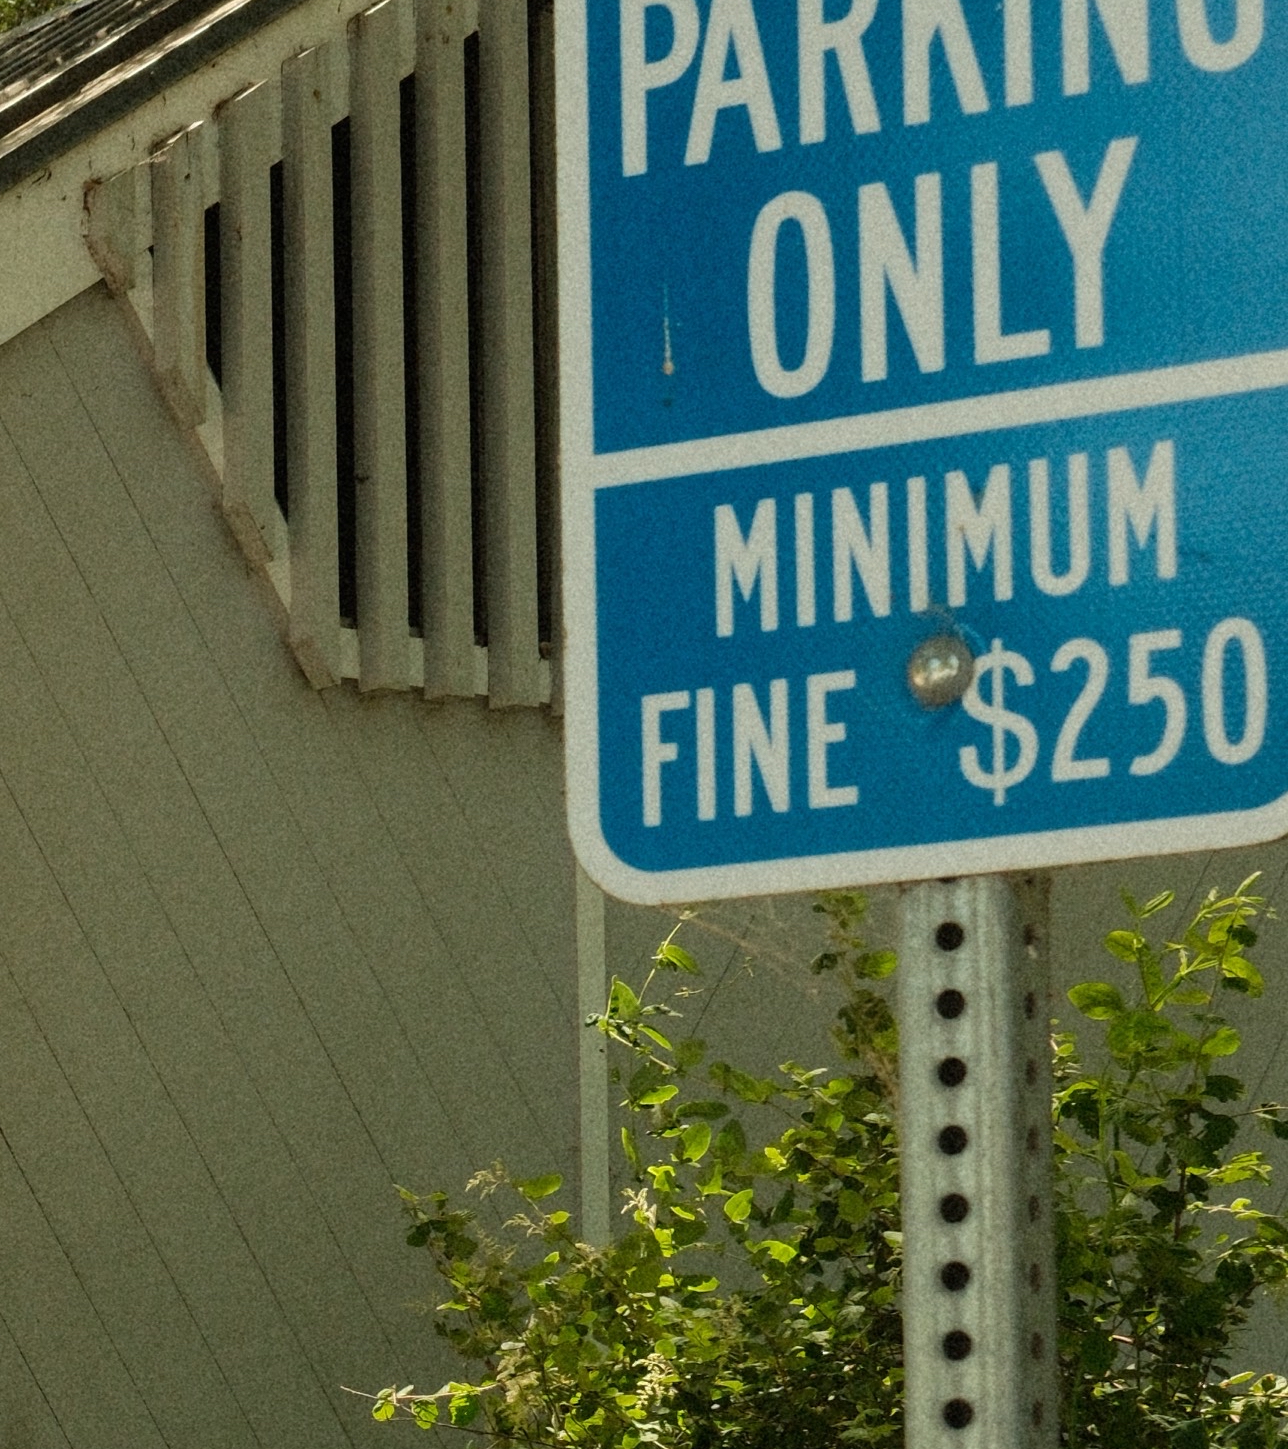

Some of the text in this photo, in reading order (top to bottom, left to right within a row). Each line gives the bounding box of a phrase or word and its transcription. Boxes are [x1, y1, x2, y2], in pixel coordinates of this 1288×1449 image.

[748, 136, 1138, 398] ONLY
[715, 439, 1178, 637] MINIMUM
[642, 616, 1268, 827] FINE $250
